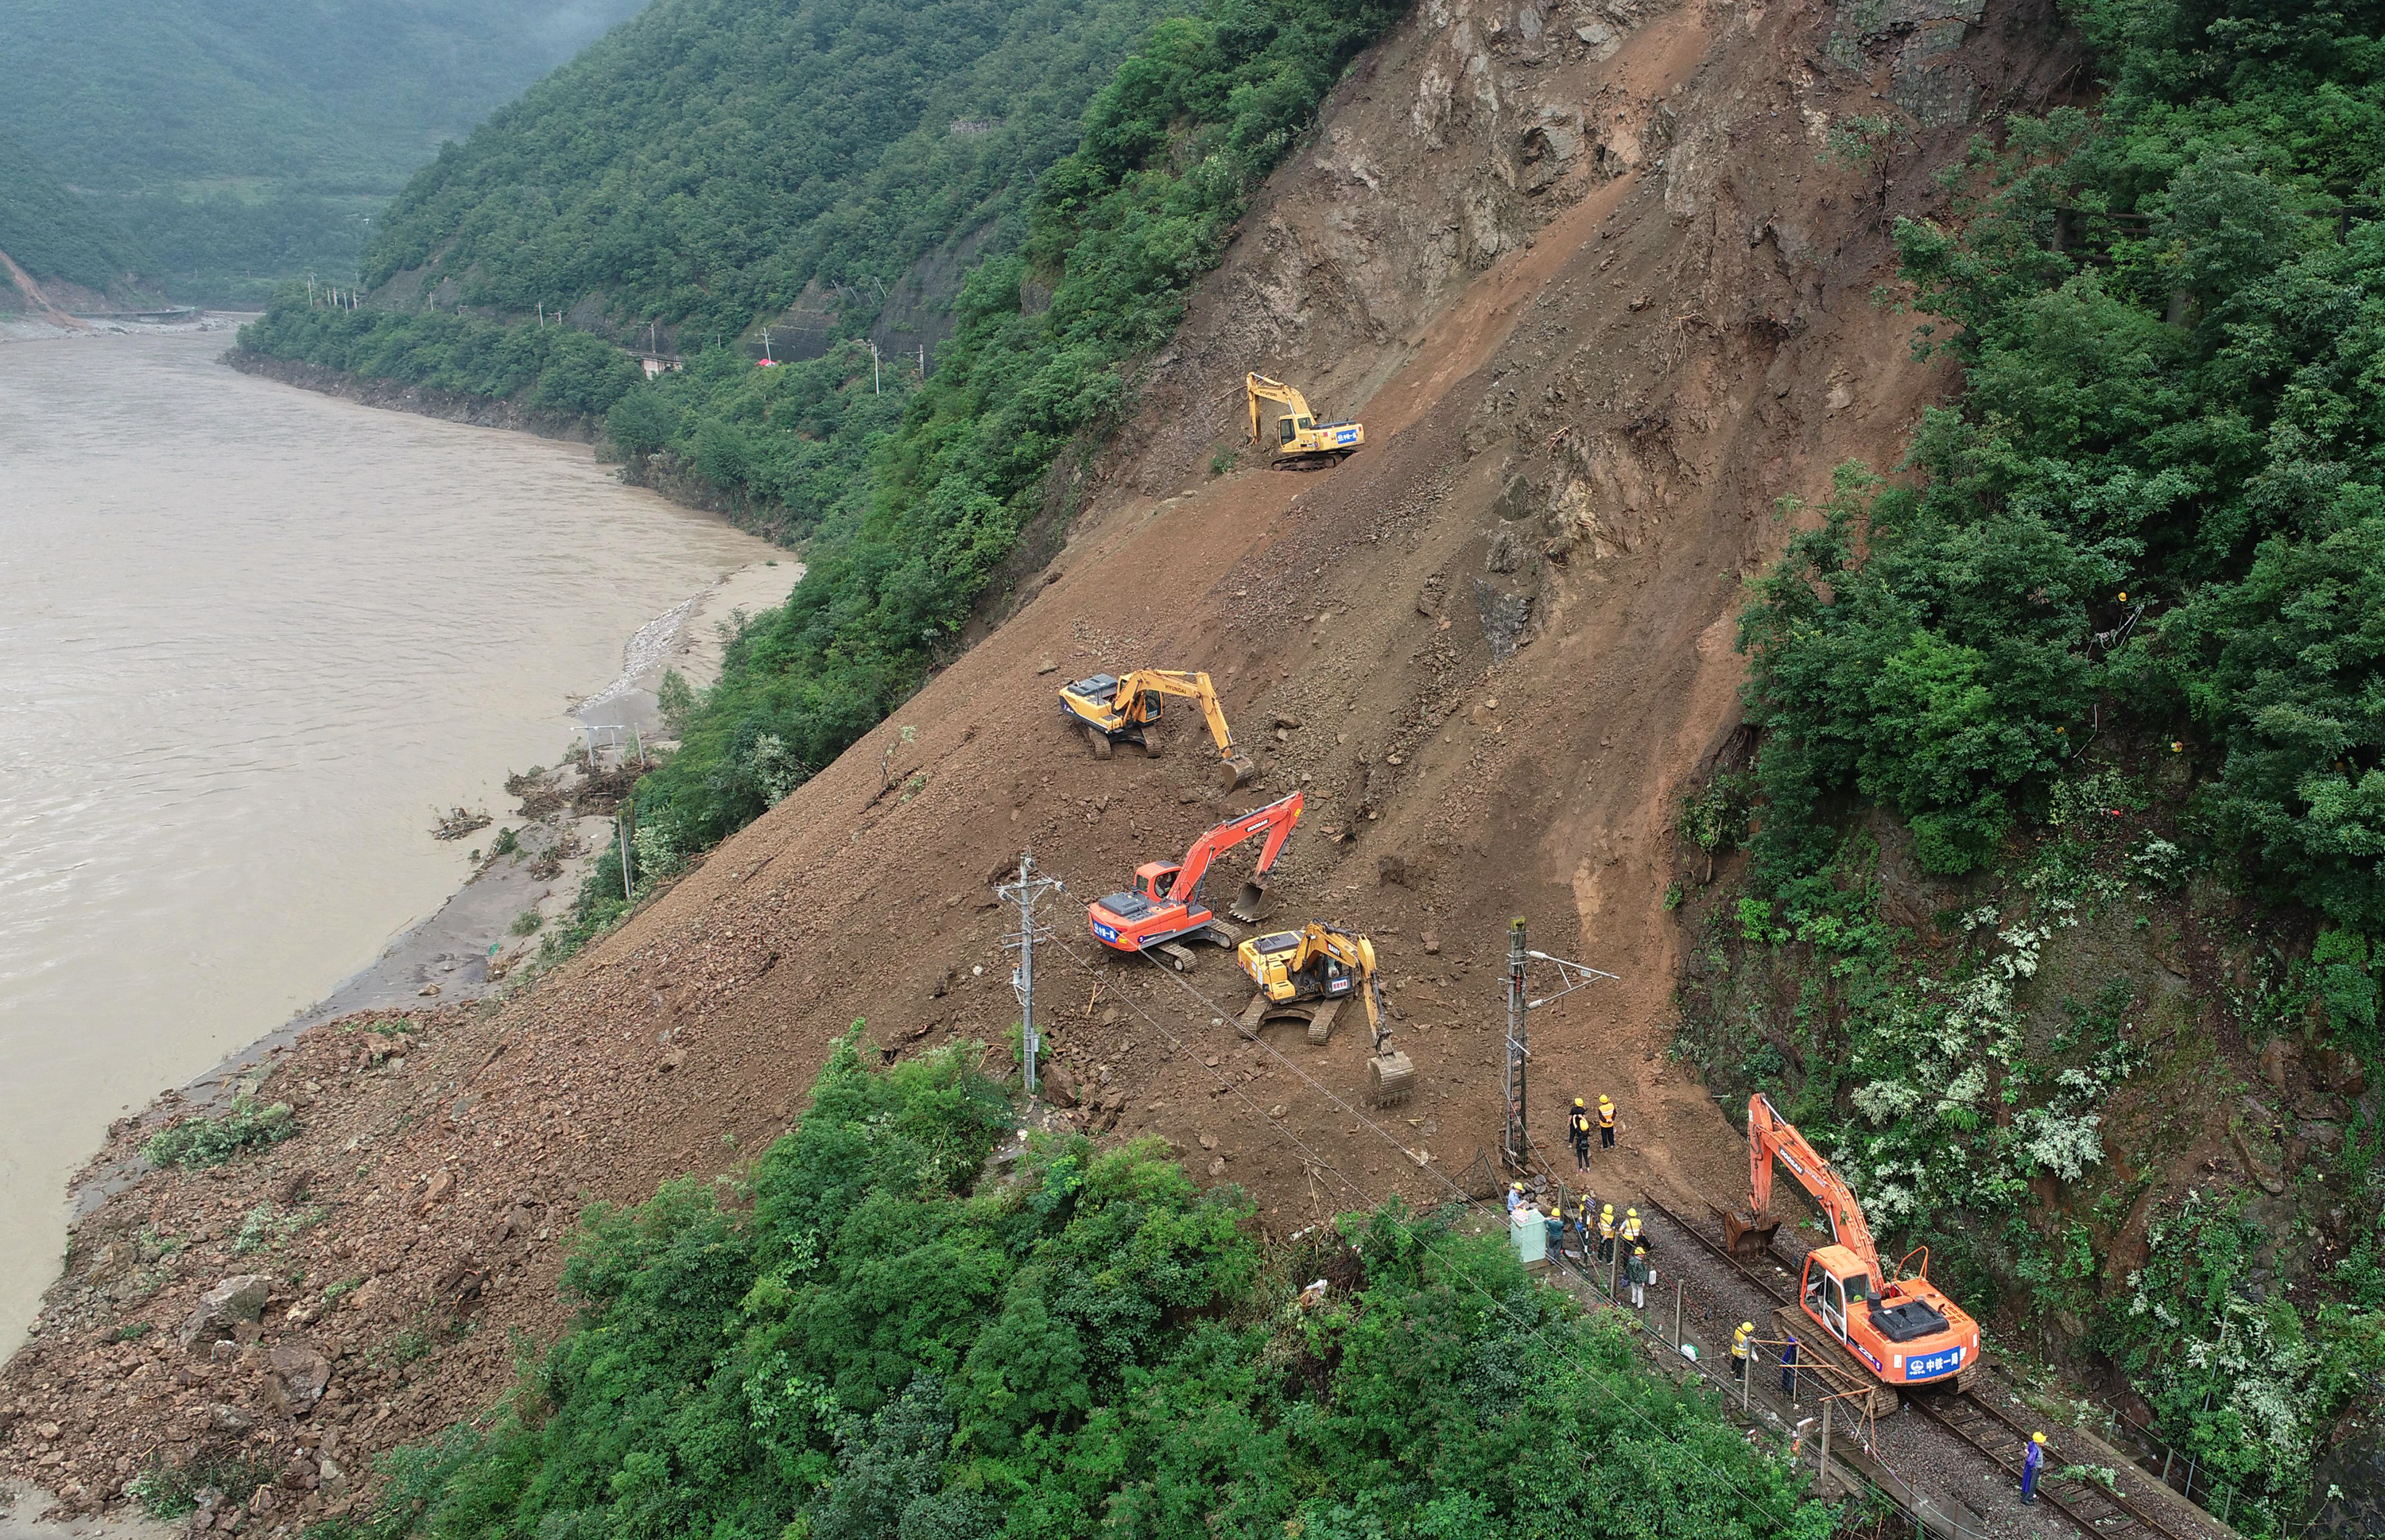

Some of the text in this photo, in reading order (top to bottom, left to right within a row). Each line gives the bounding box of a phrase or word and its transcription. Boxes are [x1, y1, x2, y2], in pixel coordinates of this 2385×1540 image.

[1165, 684, 1187, 694] HYUNDAI
[1247, 818, 1269, 832] DOOSAN
[1328, 943, 1340, 956] SANY
[1779, 1148, 1803, 1174] DOOSAN
[1925, 1352, 1959, 1373] 中铁一局
